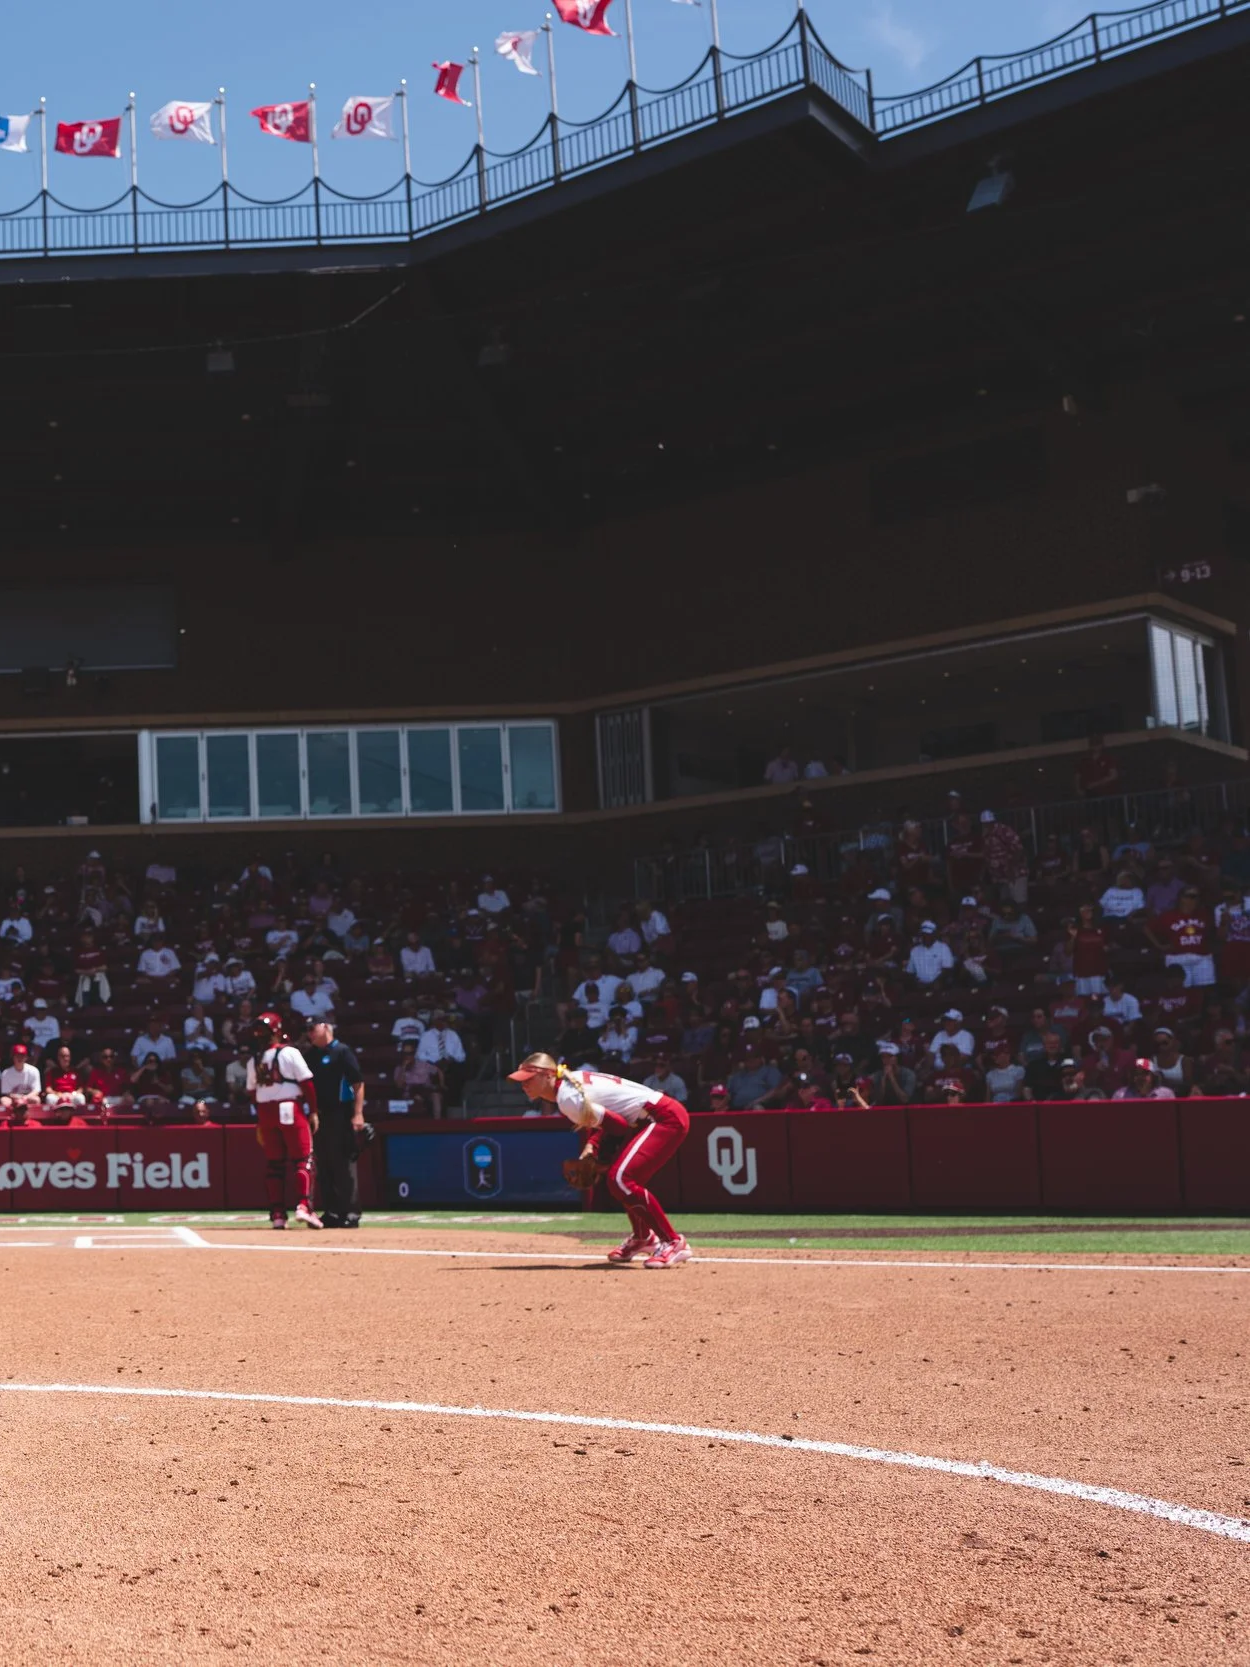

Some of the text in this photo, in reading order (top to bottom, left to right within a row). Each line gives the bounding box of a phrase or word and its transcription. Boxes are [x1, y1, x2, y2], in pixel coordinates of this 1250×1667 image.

[106, 1152, 210, 1189] Field
[707, 1126, 758, 1195] OU
[398, 1182, 409, 1197] 0
